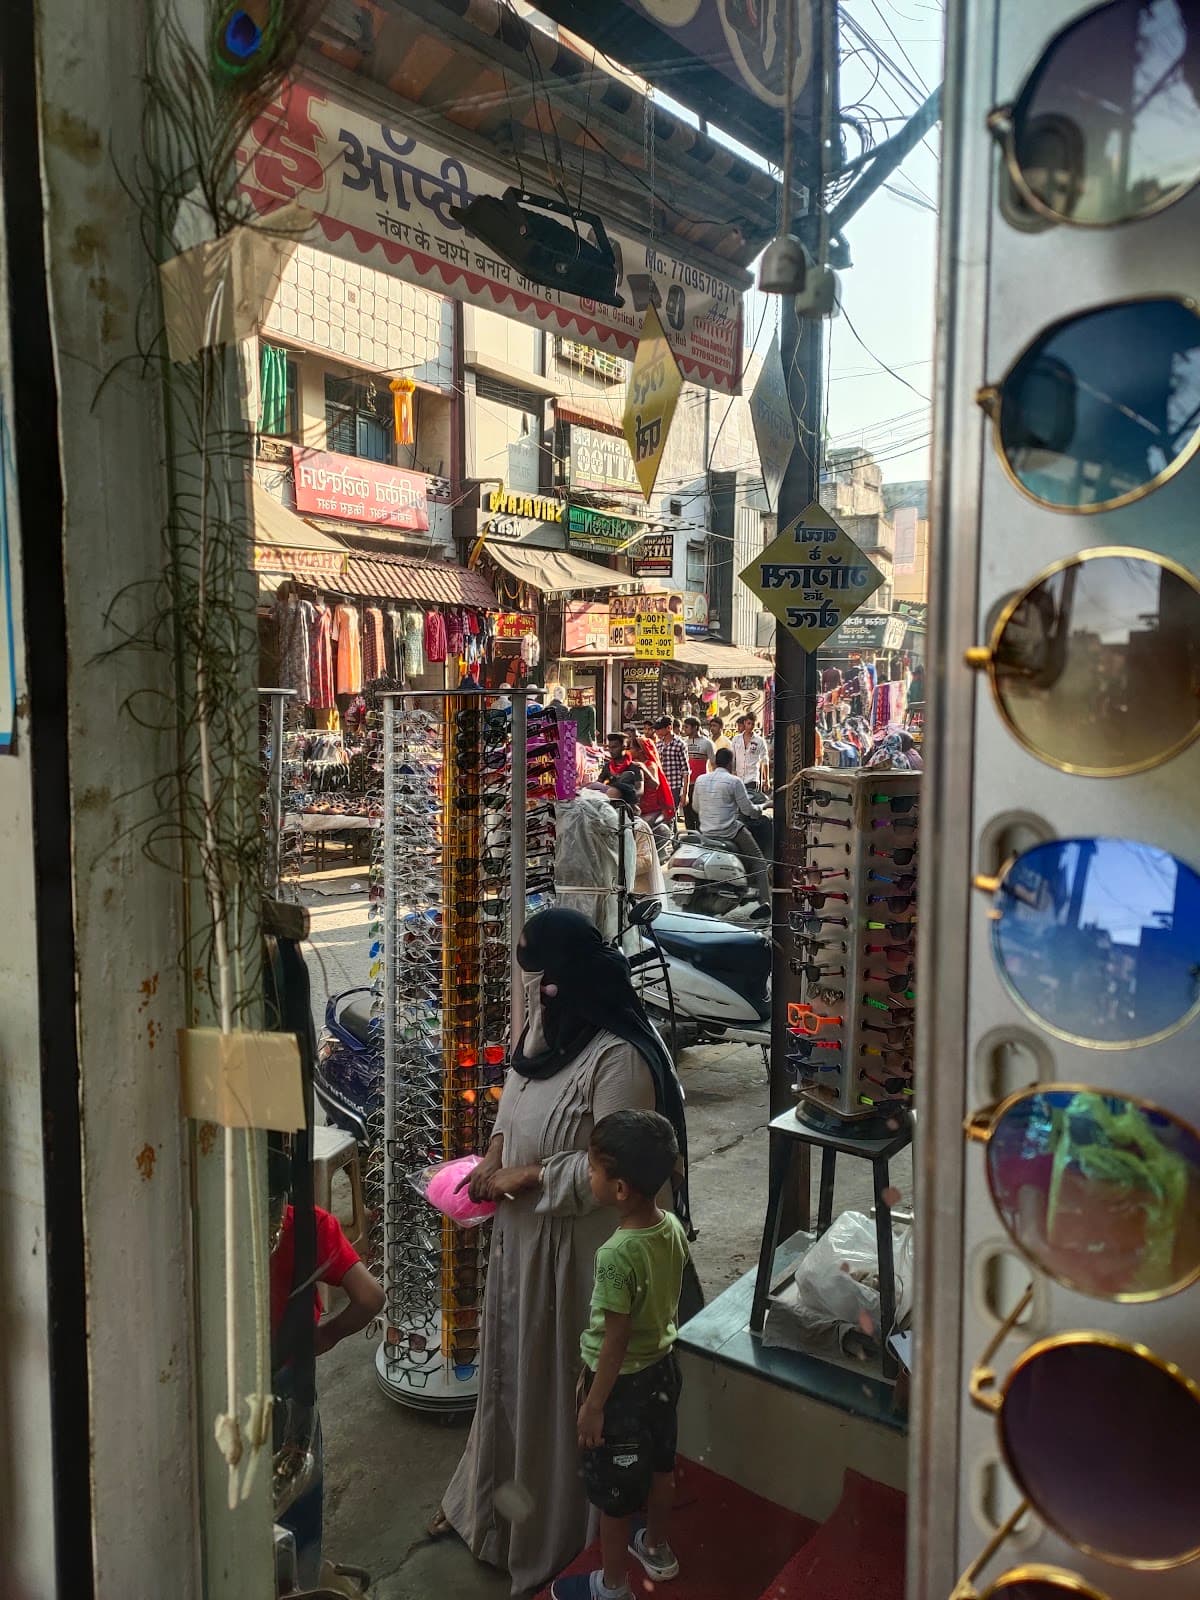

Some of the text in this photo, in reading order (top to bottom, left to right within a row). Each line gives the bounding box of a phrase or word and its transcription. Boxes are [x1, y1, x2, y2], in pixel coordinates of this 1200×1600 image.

[376, 209, 412, 244] नंबर
[413, 222, 431, 252] के
[435, 238, 469, 268] चश्मे
